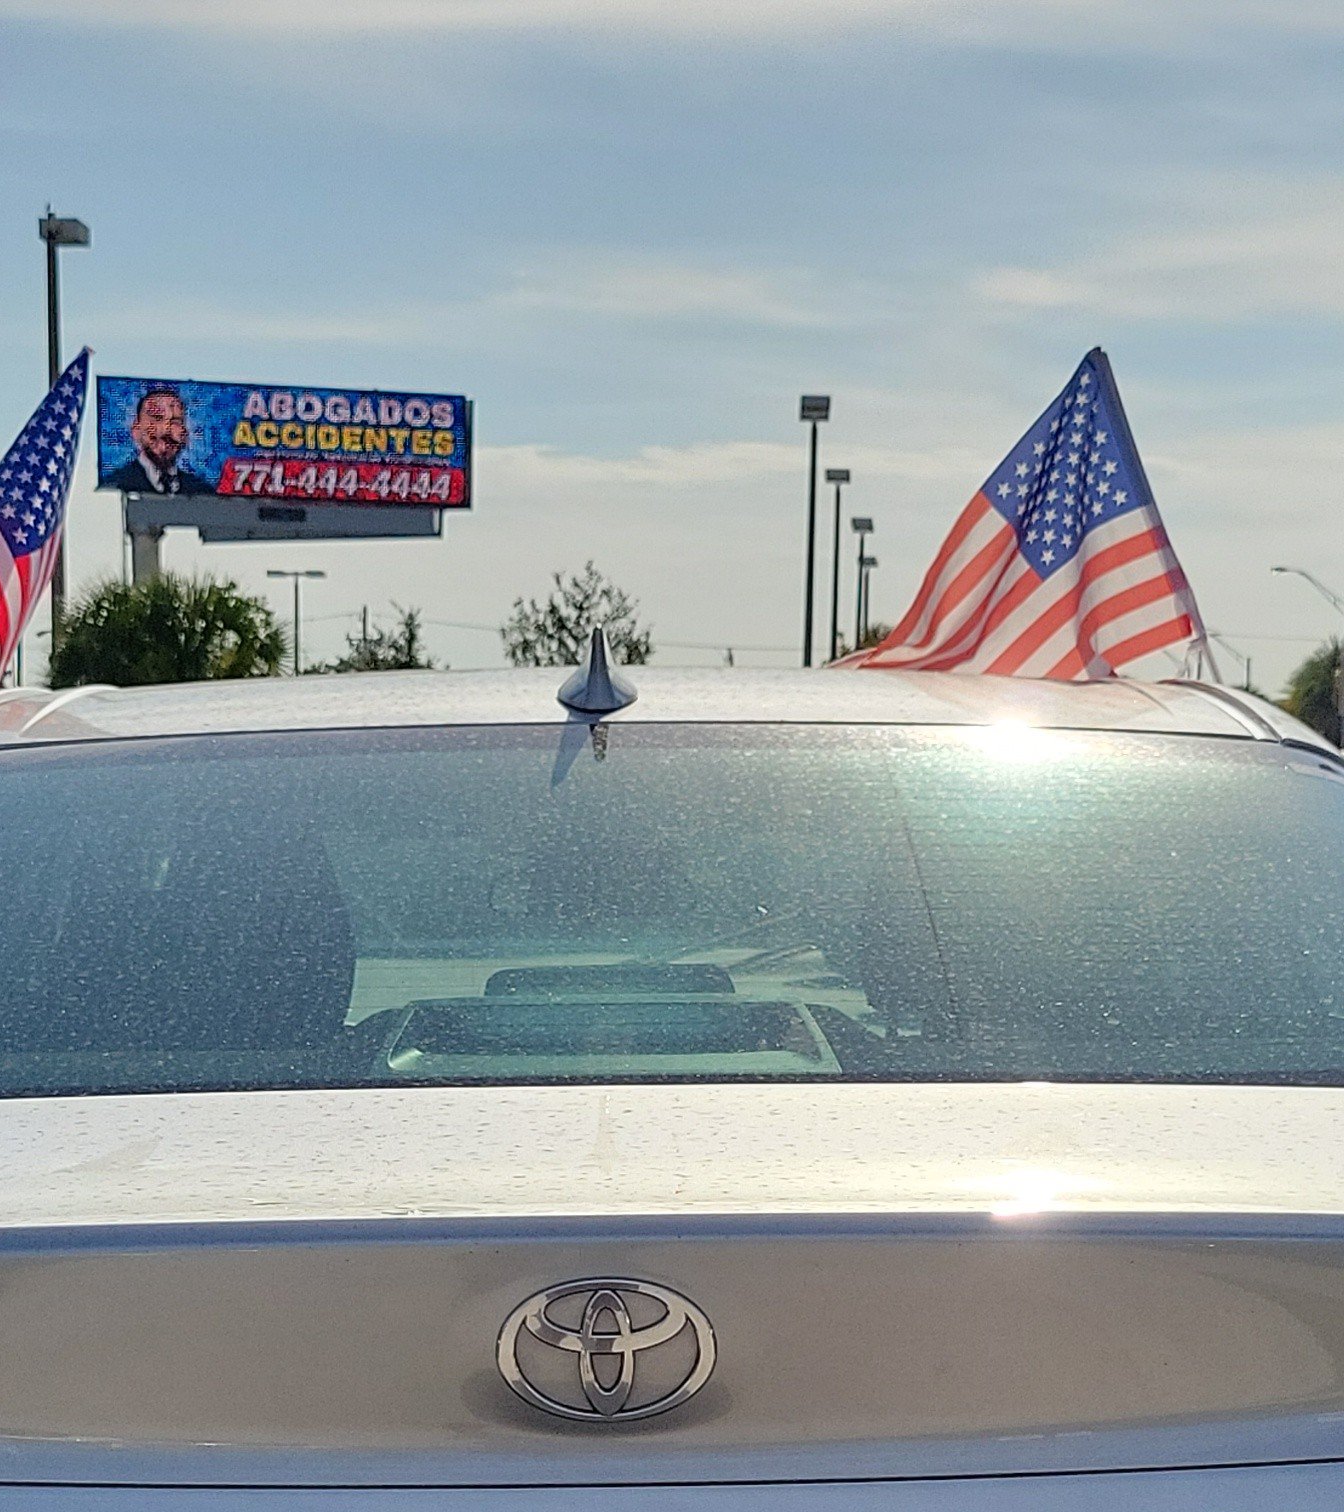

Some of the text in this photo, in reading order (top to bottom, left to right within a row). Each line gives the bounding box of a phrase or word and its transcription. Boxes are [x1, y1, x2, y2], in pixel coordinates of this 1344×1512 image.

[243, 390, 455, 428] ABOGADOS
[233, 421, 455, 456] ACCIDENTES
[232, 462, 452, 499] 771-444-4444
